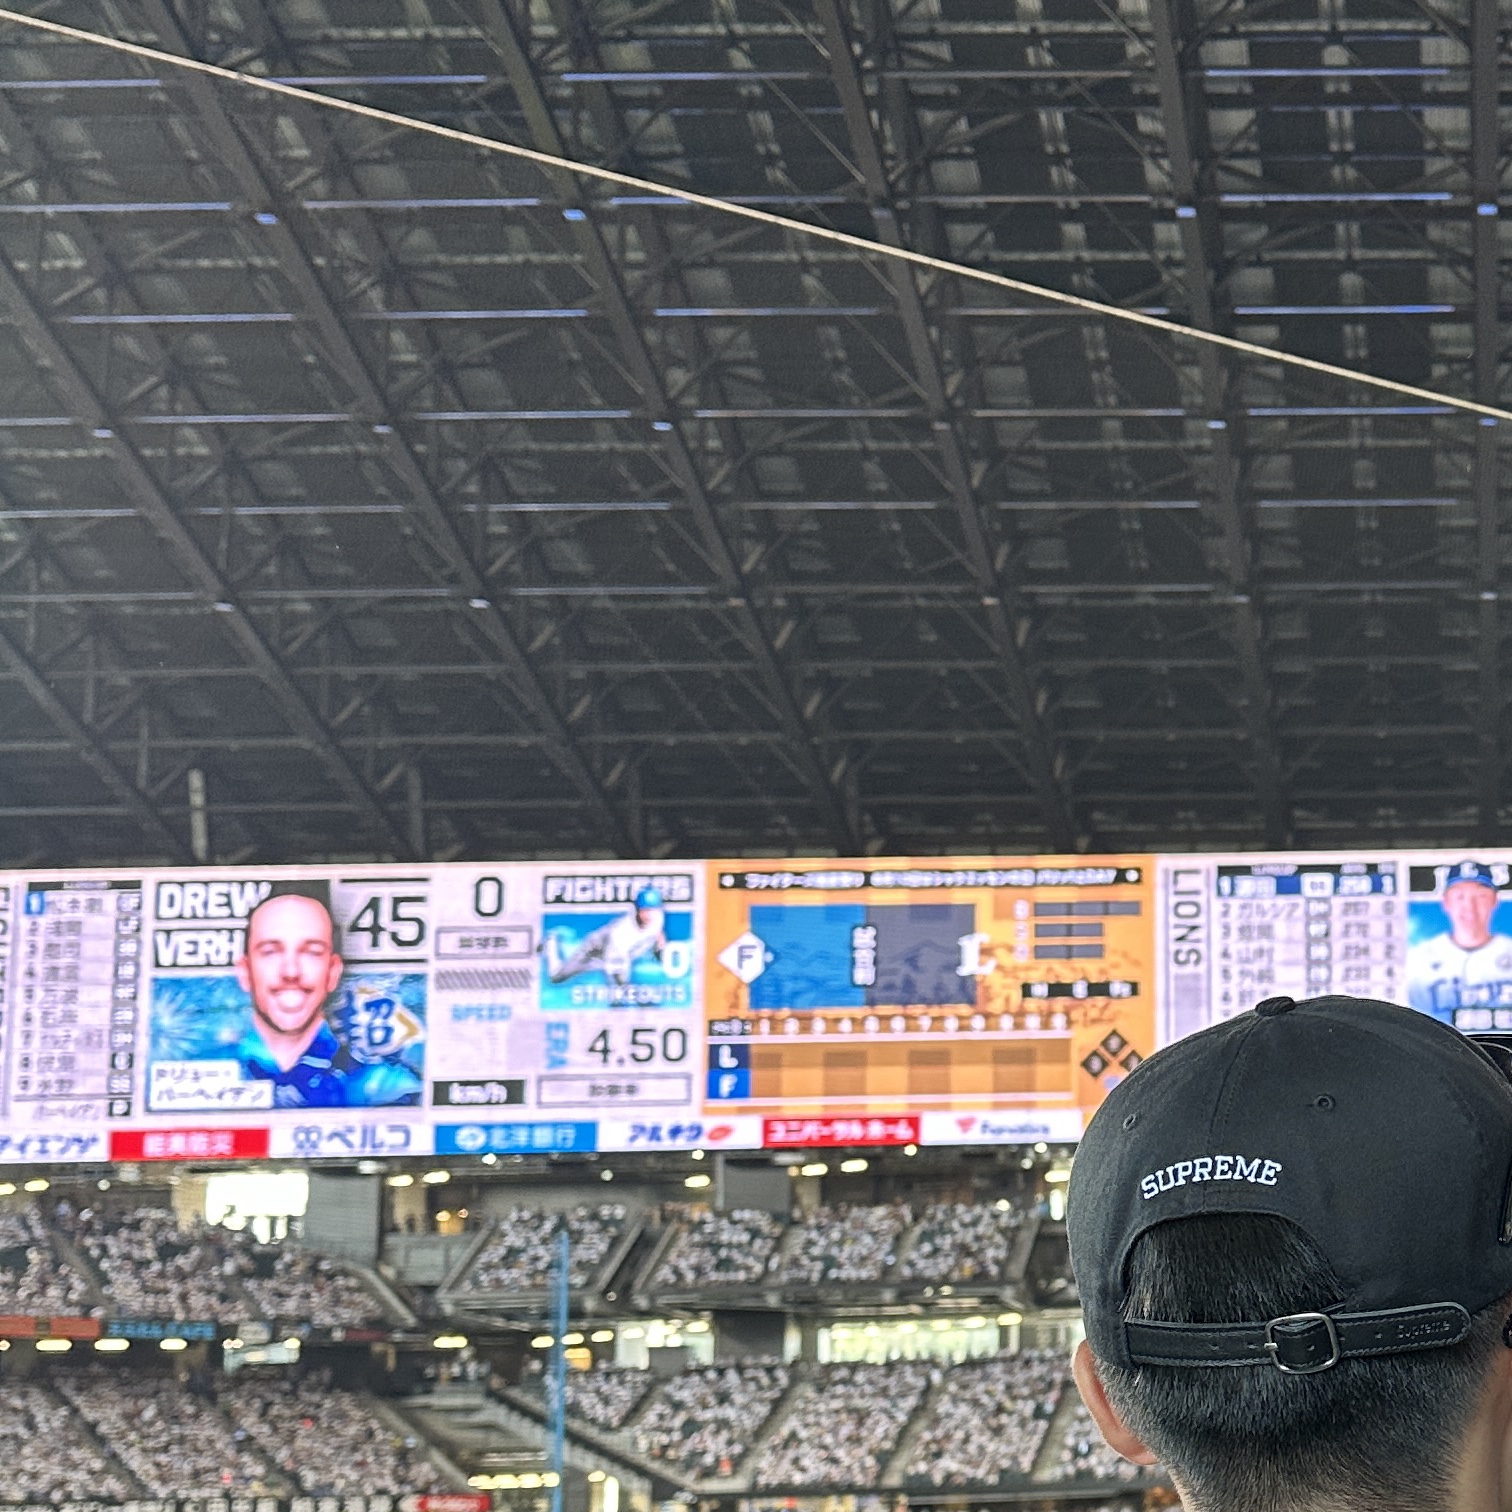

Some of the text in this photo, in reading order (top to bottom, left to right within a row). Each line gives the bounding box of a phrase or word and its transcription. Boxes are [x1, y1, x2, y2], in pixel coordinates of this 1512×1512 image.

[158, 882, 271, 918] DREW
[475, 875, 502, 918] 0
[348, 895, 427, 948] 45
[1173, 868, 1201, 966] LIONS
[662, 940, 691, 979] 0
[737, 944, 758, 970] F
[955, 932, 997, 977] L
[452, 1005, 513, 1021] SPEED
[545, 1022, 569, 1070] ERA
[589, 1027, 687, 1066] 4.50
[719, 1044, 739, 1069] L
[449, 1082, 507, 1105] km/h
[718, 1073, 739, 1098] F
[325, 1124, 412, 1151] ベルコ
[1141, 1155, 1283, 1200] SUPREME
[1398, 1320, 1450, 1340] Supreme
